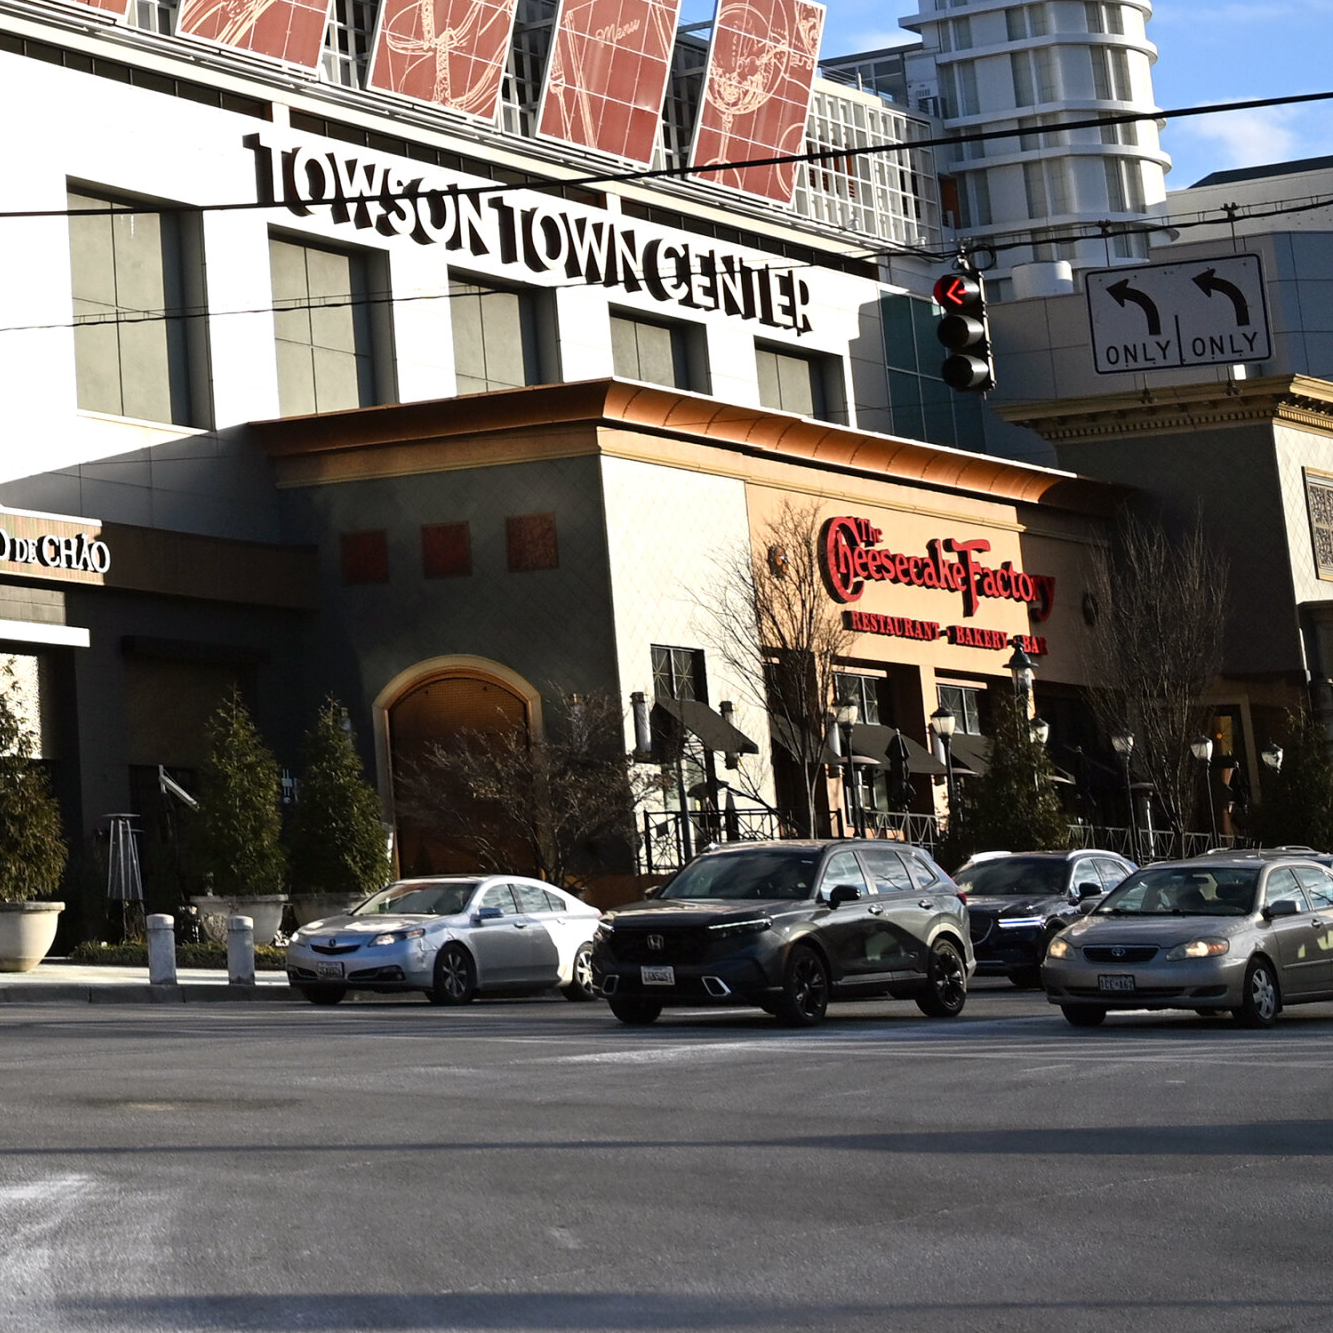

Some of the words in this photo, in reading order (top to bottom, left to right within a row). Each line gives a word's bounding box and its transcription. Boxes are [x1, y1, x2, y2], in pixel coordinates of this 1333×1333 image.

[244, 133, 490, 255] TOWSON
[488, 196, 643, 293] TOWN
[644, 237, 813, 335] CENTER
[1106, 340, 1170, 365] ONLY
[1192, 332, 1257, 357] ONLY
[855, 518, 884, 544] The
[15, 538, 38, 564] DE
[820, 516, 968, 603] Cheesecake
[946, 538, 1055, 621] Factory
[846, 610, 940, 642] RESTAURANT
[952, 625, 1009, 651] BAKERY
[1022, 634, 1048, 656] BAR
